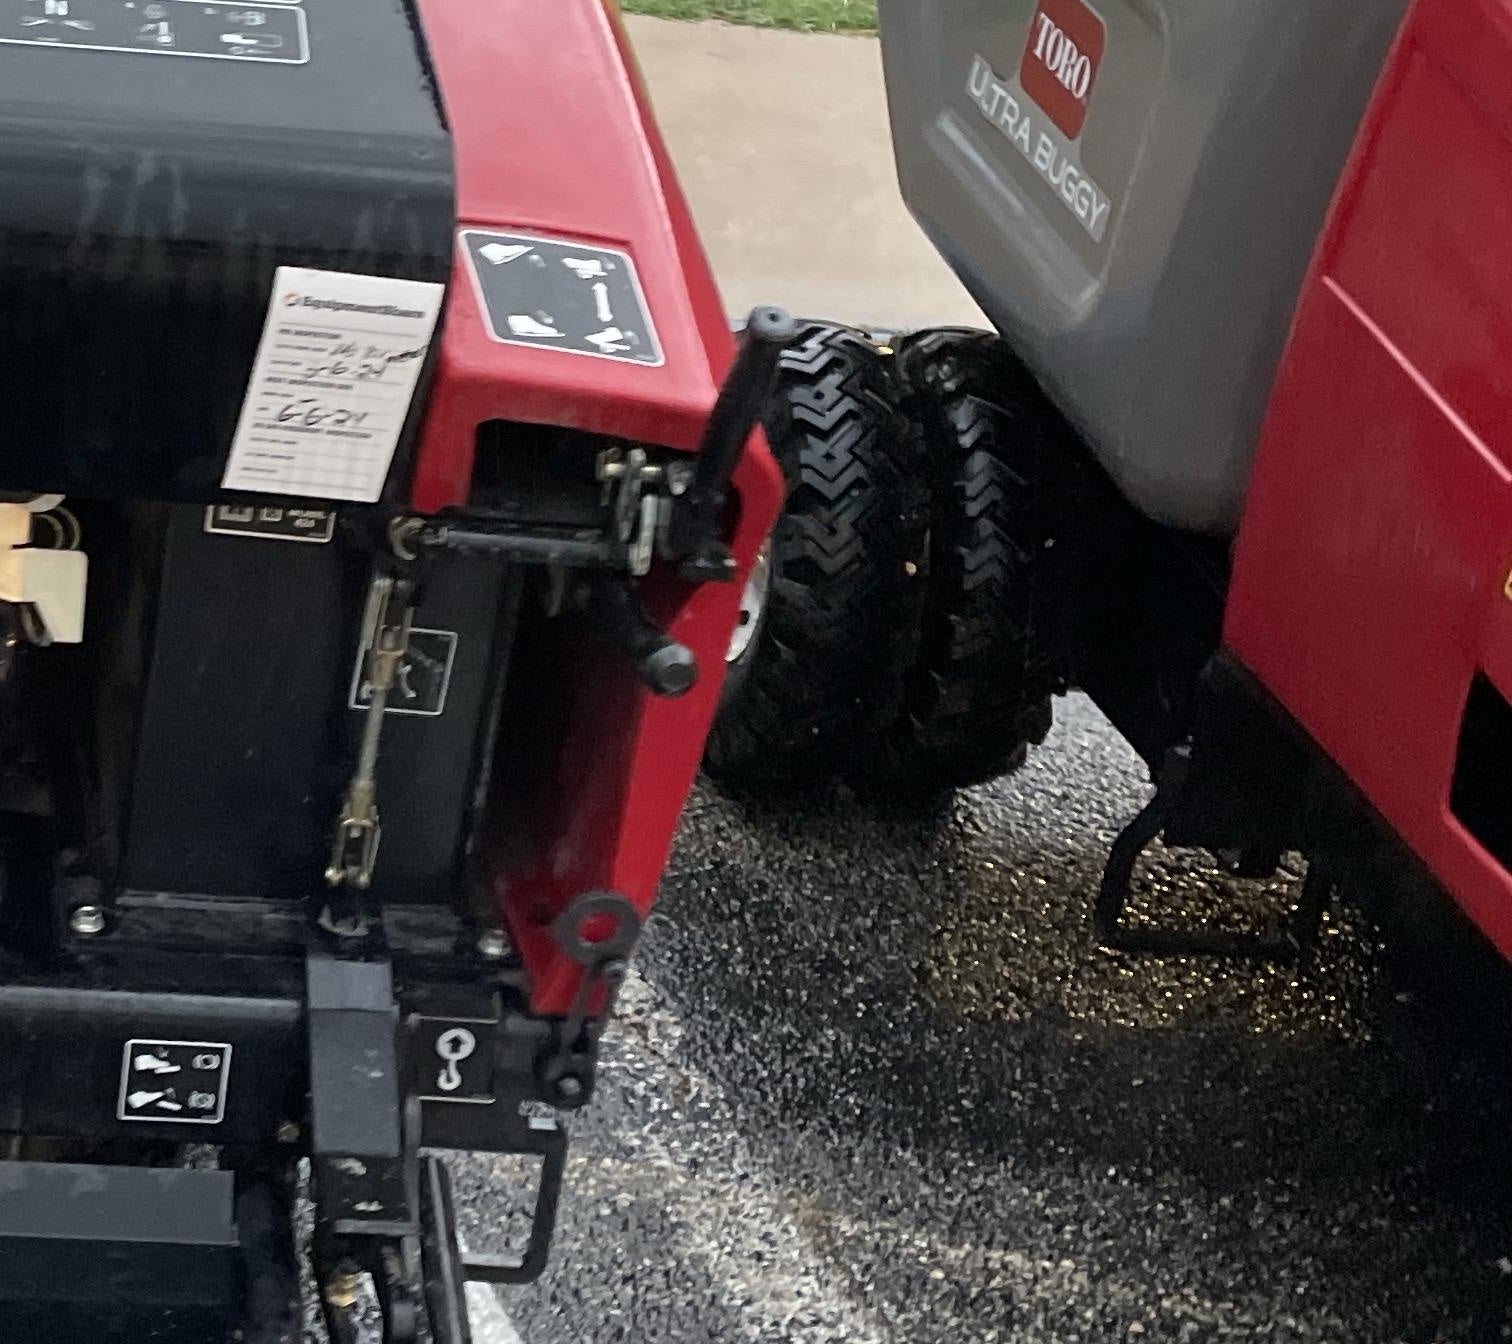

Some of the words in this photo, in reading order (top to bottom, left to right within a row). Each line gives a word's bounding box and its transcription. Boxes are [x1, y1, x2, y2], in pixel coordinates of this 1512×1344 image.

[1032, 11, 1092, 99] TORO
[968, 60, 1030, 154] ULTRA
[1034, 132, 1107, 230] BUGGY
